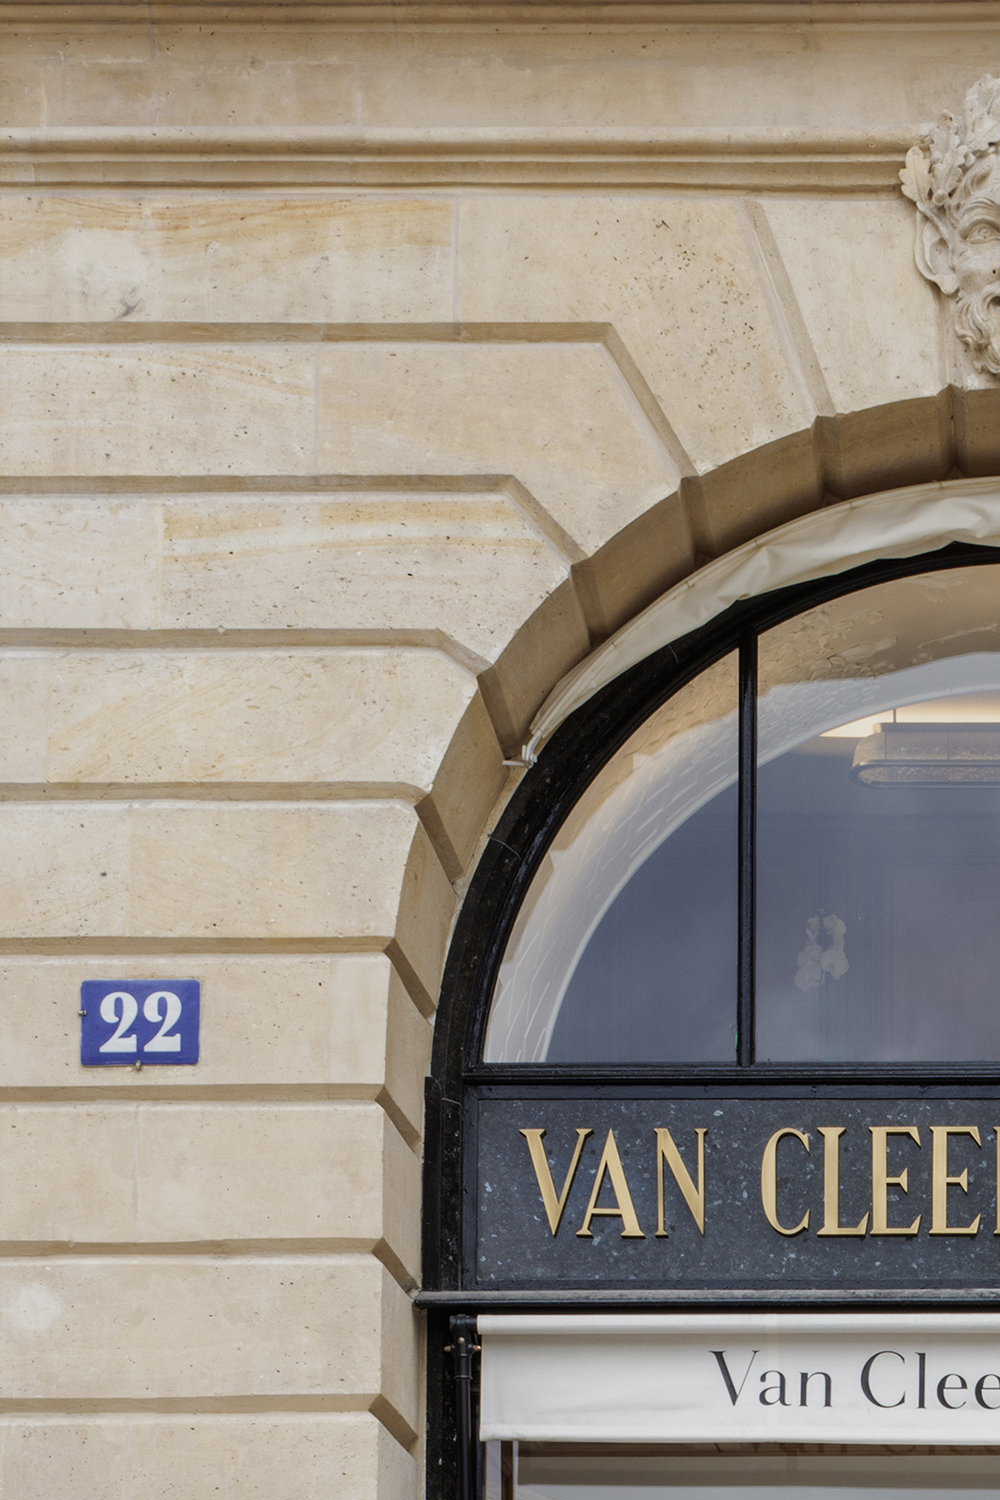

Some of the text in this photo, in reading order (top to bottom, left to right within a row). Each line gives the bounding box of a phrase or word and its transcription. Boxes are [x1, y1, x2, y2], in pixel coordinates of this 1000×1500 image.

[99, 991, 183, 1053] 22
[518, 1127, 709, 1239] VAN
[707, 1349, 833, 1409] Van
